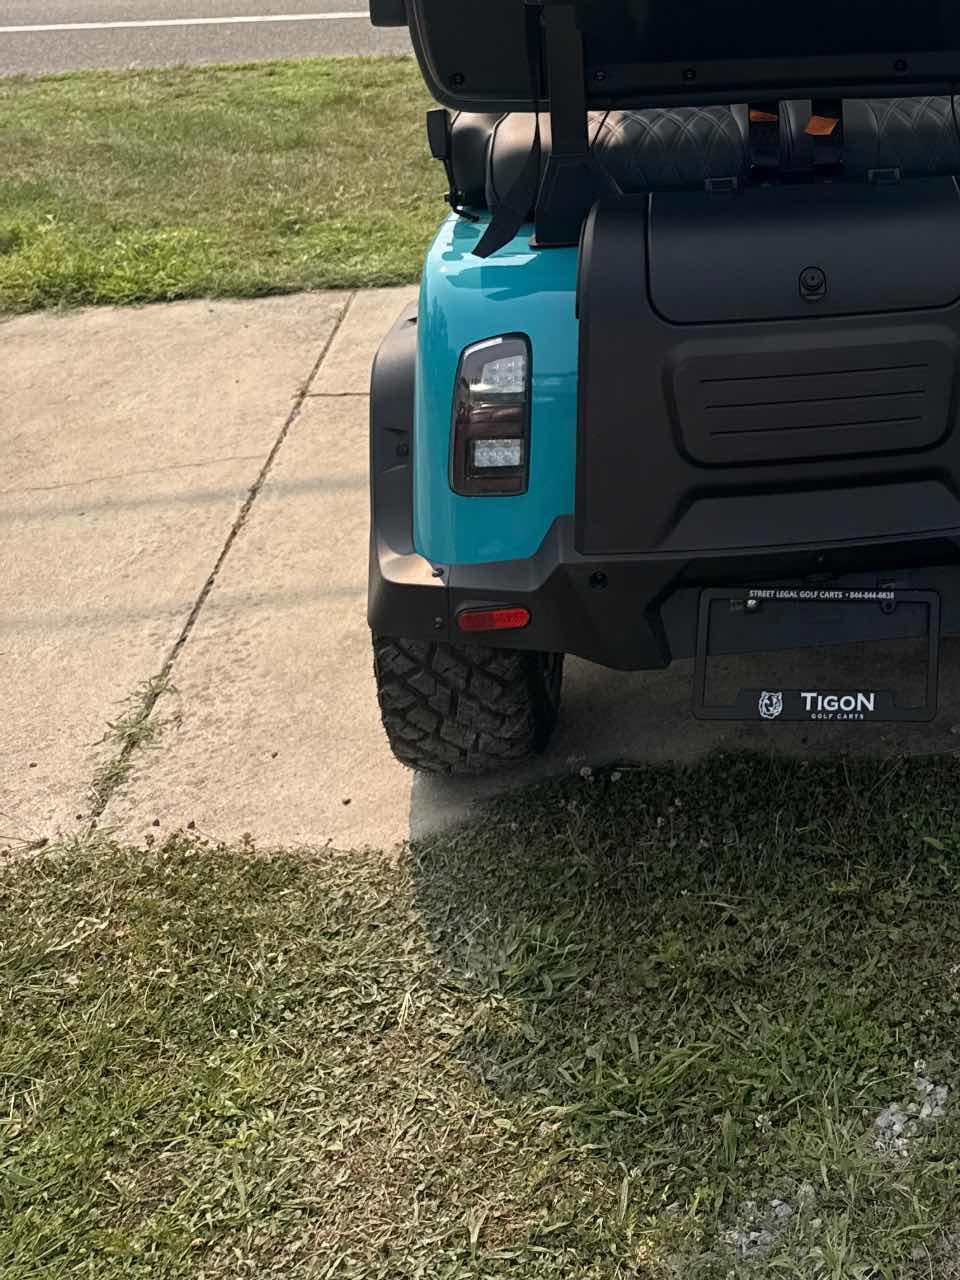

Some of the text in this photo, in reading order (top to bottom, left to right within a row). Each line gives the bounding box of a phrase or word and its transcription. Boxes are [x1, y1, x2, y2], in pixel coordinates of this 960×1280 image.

[749, 589, 775, 599] STREET
[776, 590, 798, 599] LEGAL
[800, 590, 818, 599] GOLF
[819, 591, 843, 599] CARTS
[800, 692, 875, 712] TIGON
